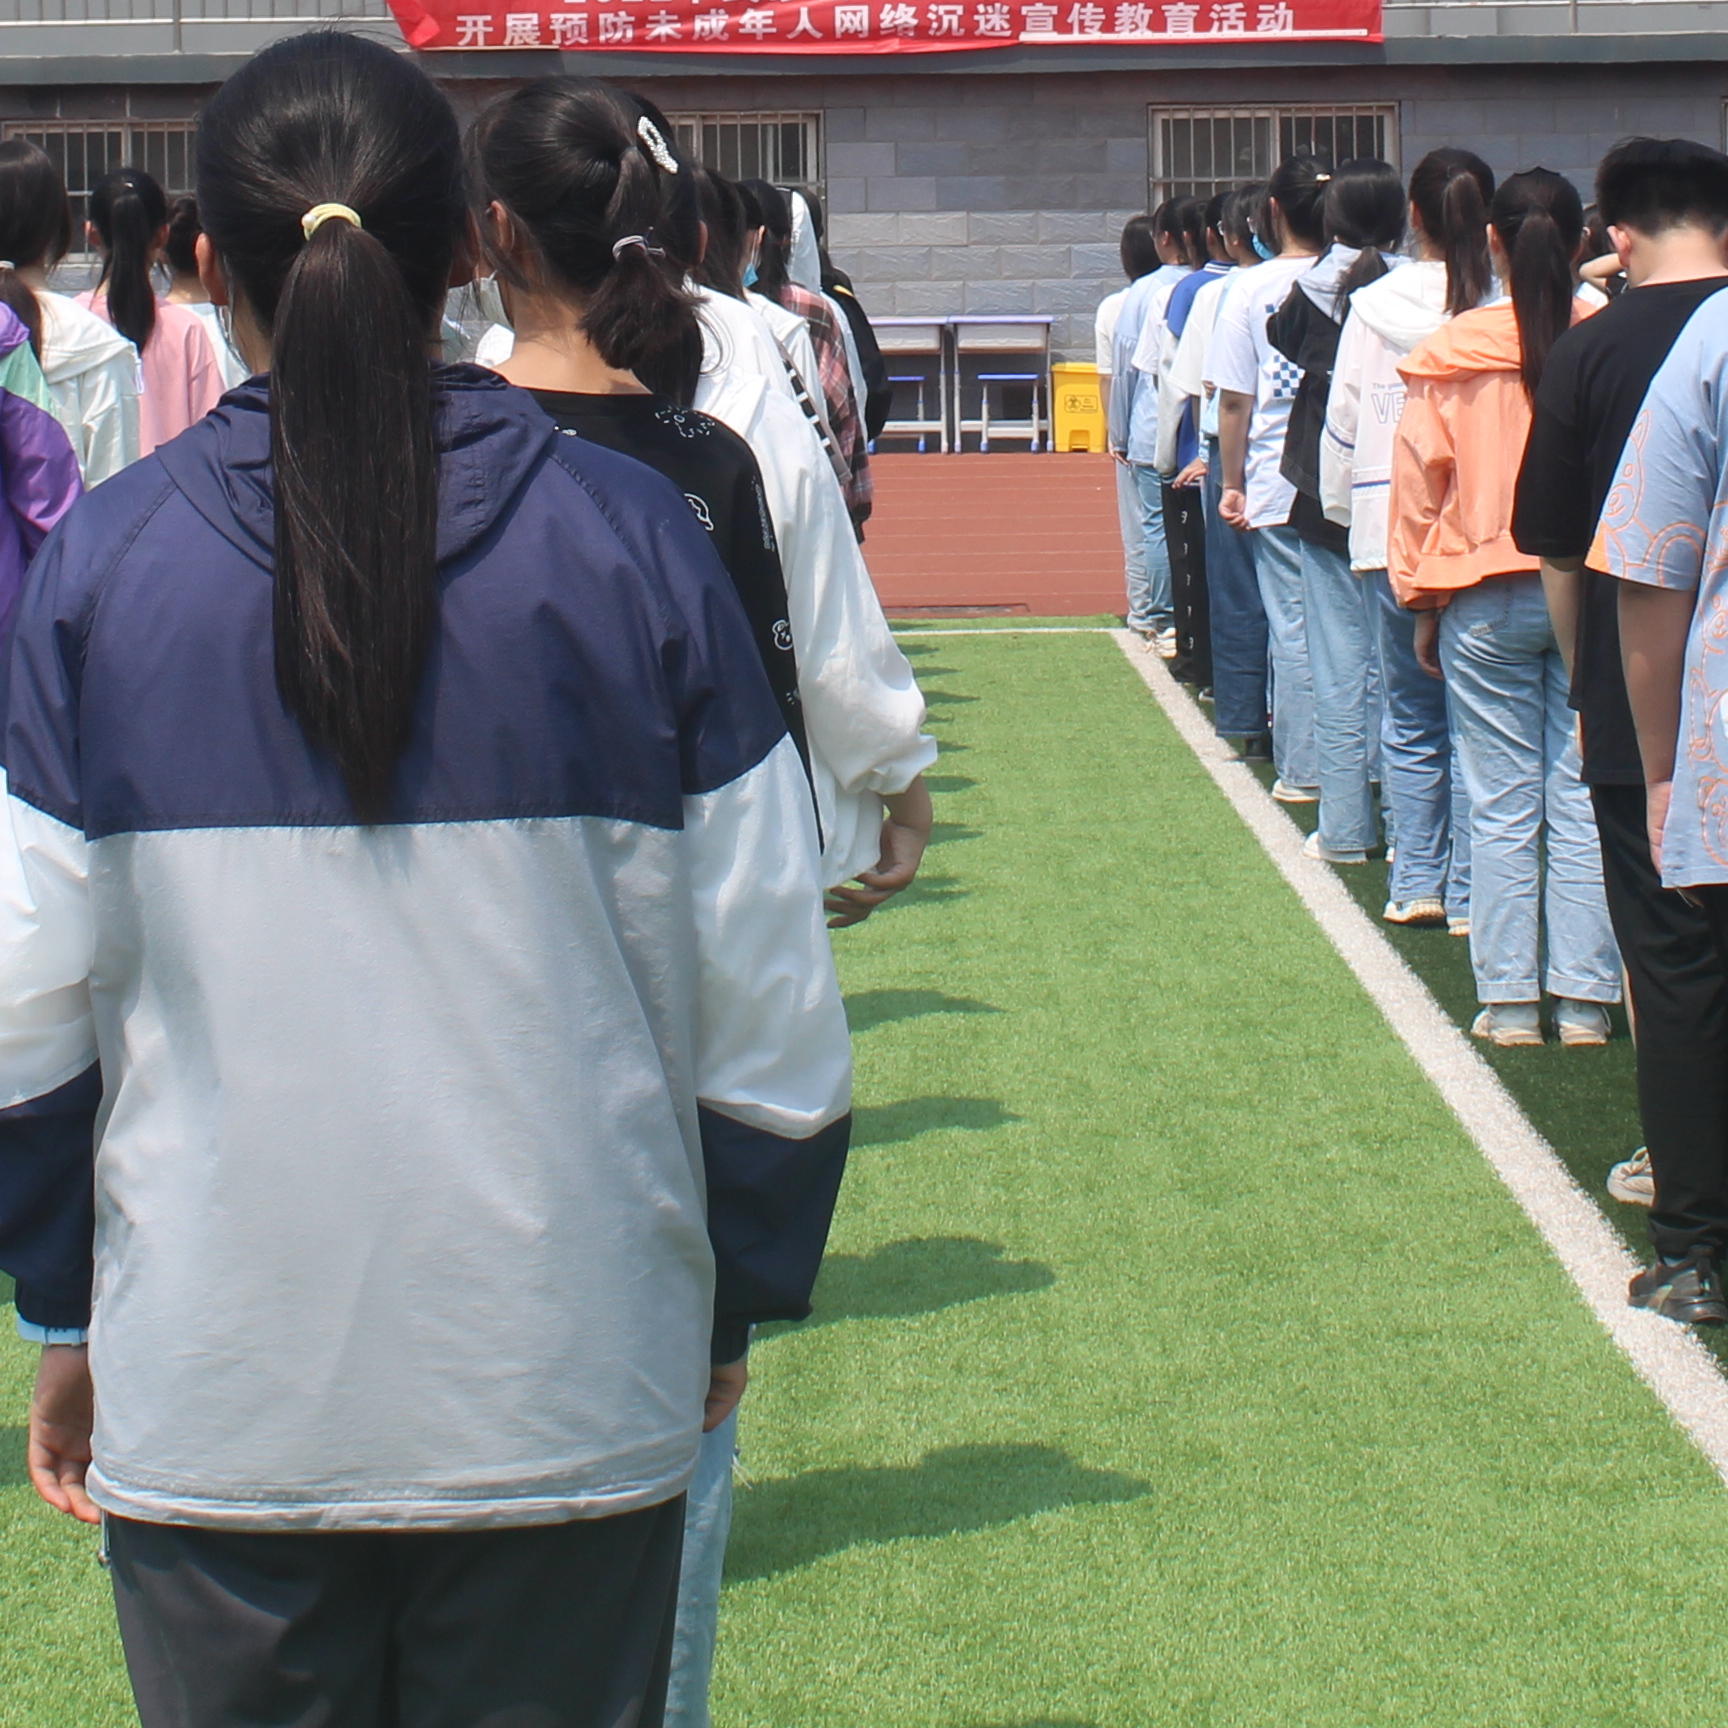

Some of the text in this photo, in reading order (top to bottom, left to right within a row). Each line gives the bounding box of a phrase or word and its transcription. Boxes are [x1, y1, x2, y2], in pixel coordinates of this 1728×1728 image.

[455, 1, 1294, 47] 开展预防未成年人网络沉迷宣传教育活动
